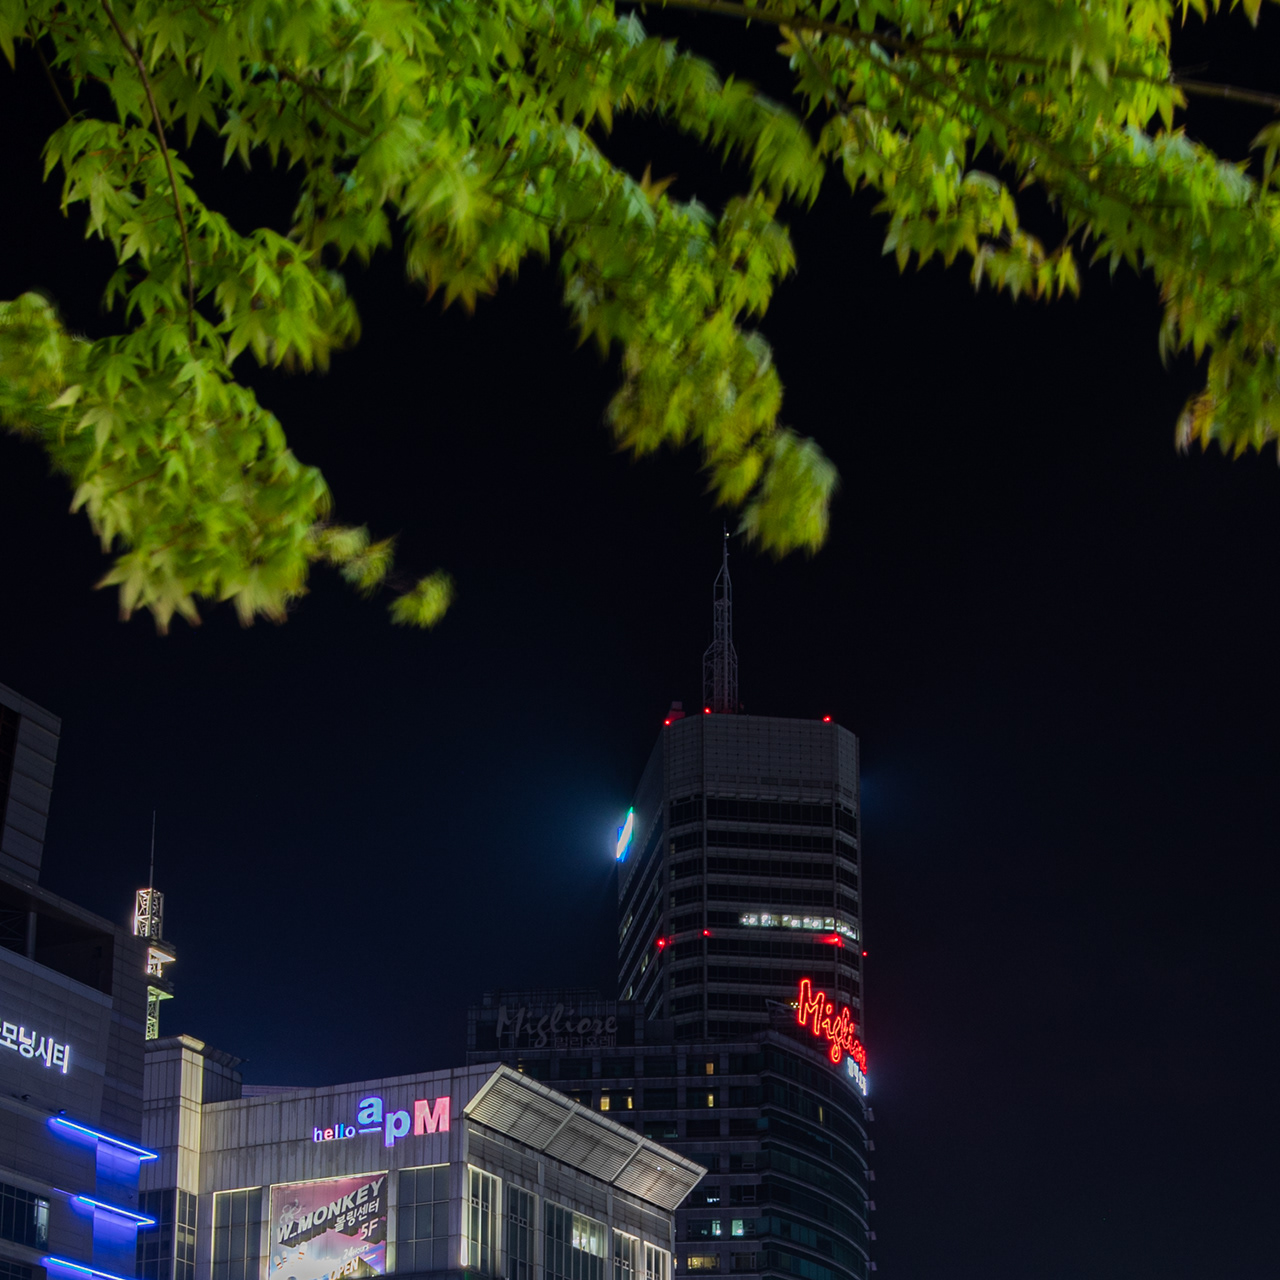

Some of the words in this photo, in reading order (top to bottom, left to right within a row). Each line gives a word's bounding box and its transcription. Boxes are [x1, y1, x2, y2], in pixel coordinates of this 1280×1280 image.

[496, 1003, 618, 1048] Migliore
[314, 1123, 355, 1142] hello
[358, 1095, 450, 1147] apM
[334, 1198, 380, 1233] 볼링센터
[360, 1218, 378, 1240] 5F
[329, 1256, 359, 1280] OPEN
